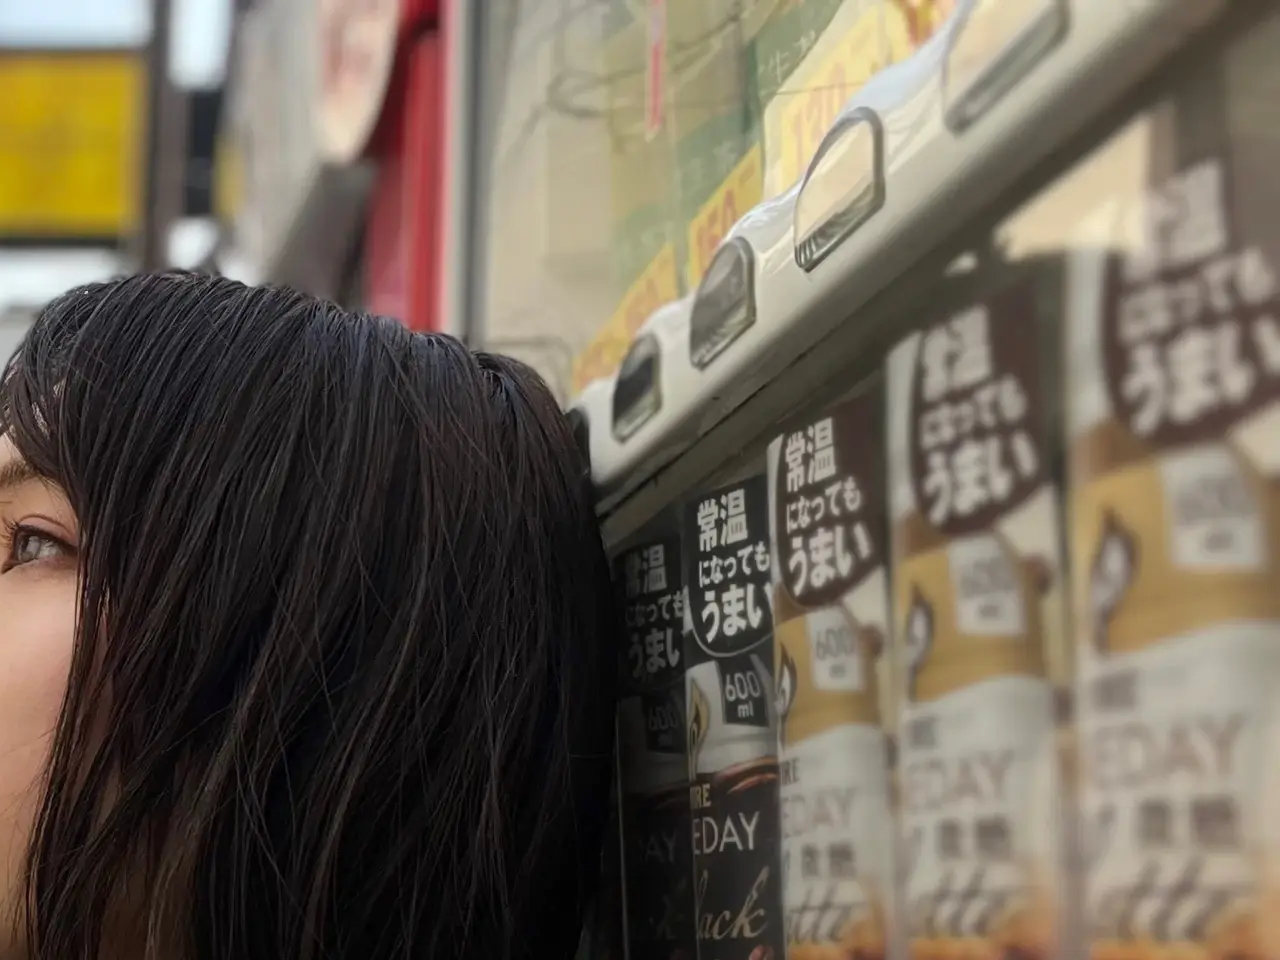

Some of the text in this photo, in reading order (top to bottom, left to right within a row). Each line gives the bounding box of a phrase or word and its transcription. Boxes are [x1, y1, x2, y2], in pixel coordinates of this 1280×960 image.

[785, 417, 836, 492] 常温
[697, 488, 749, 552] 常温
[787, 476, 861, 534] になっても
[698, 541, 771, 588] になっても
[788, 523, 872, 598] うまい
[701, 582, 774, 644] うまい
[725, 670, 761, 702] 600
[737, 701, 754, 718] ml
